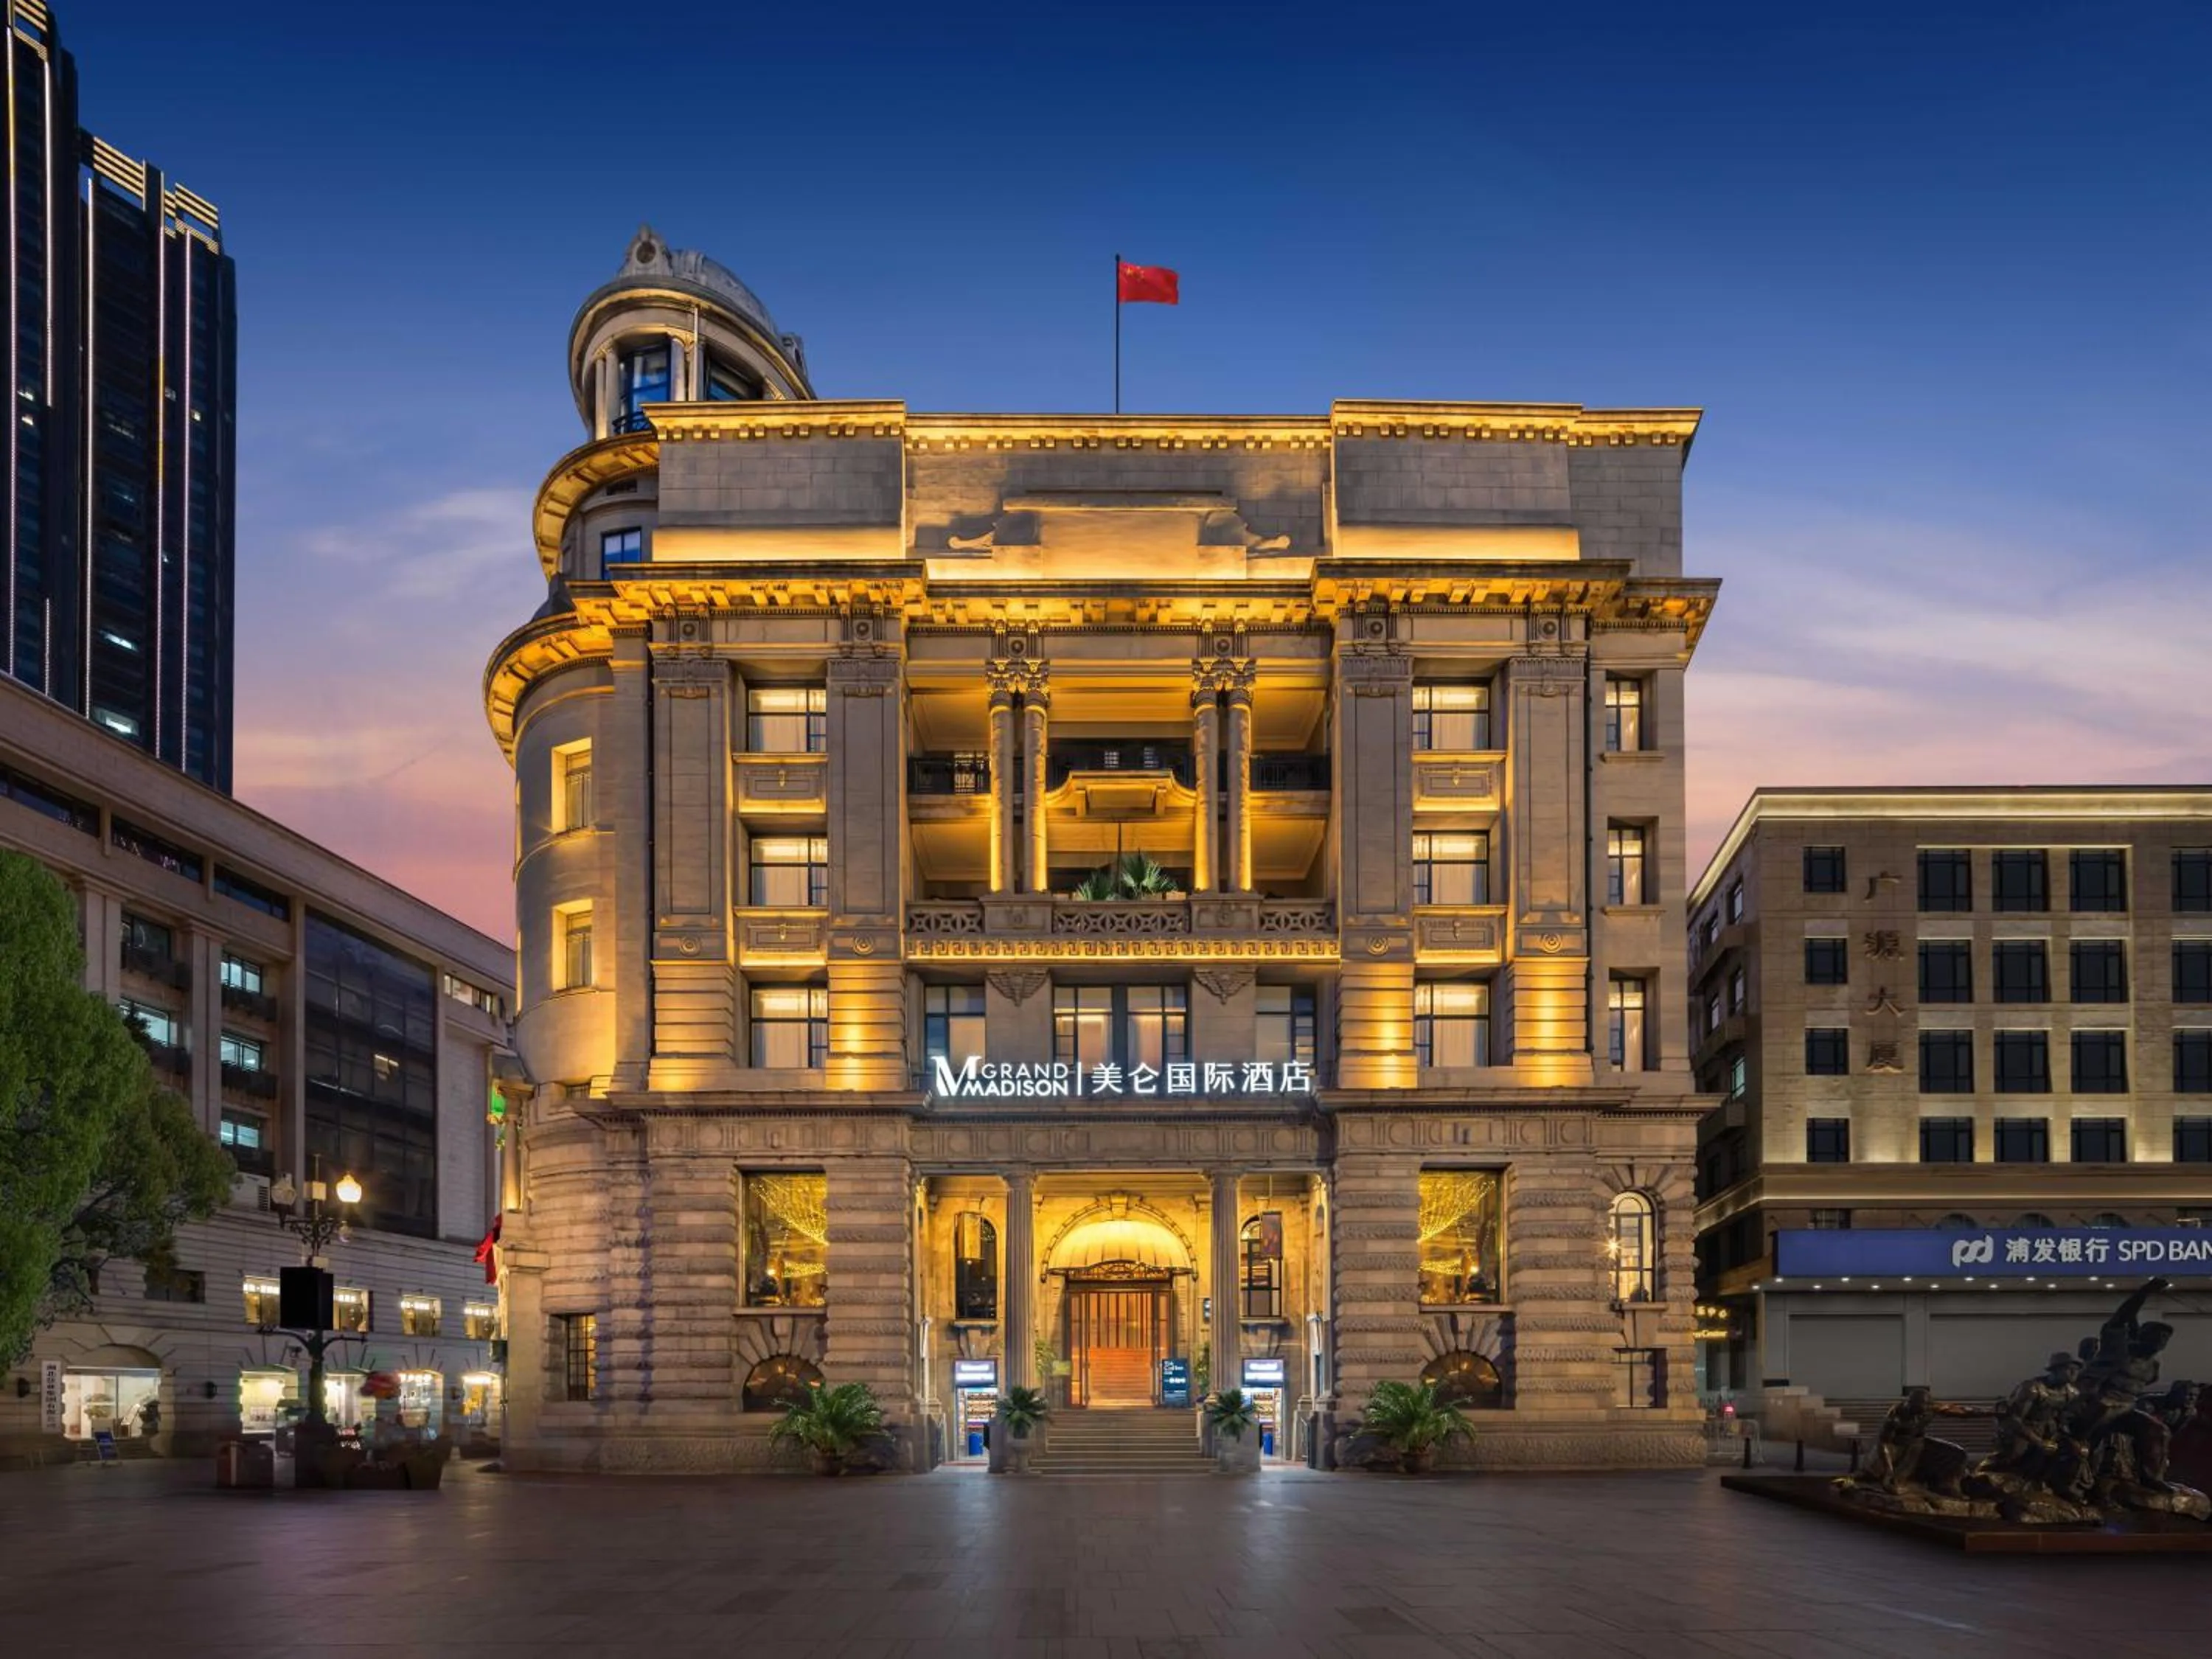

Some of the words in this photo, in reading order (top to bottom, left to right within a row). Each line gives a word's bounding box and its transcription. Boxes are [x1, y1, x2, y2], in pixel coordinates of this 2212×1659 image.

[981, 1062, 1068, 1079] GRAND
[1091, 1060, 1312, 1094] 美仑国际酒店
[961, 1079, 1068, 1096] MADISON
[2006, 1237, 2110, 1263] 浦发银行
[2118, 1239, 2165, 1262] SPD
